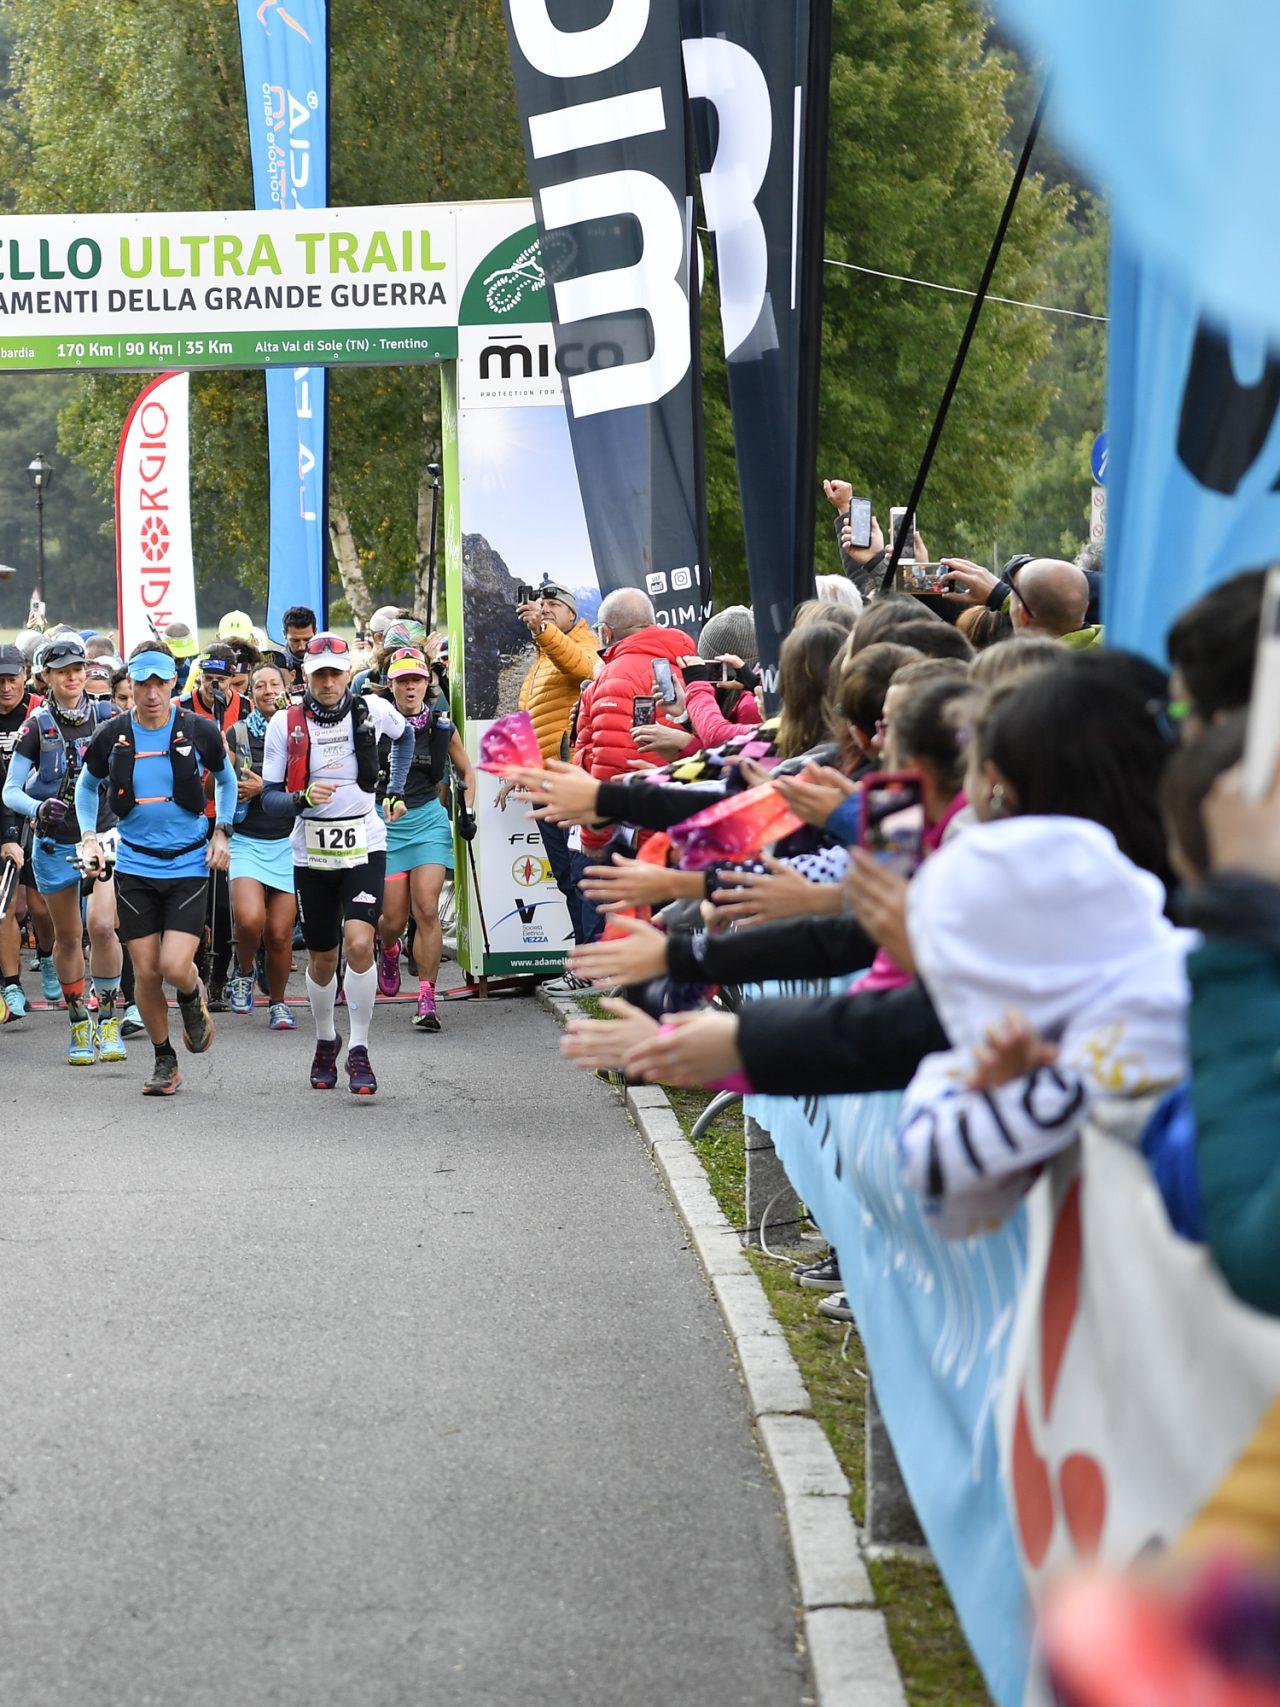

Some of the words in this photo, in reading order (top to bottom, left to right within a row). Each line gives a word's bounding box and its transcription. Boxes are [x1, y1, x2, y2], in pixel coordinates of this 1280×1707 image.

[119, 232, 282, 279] ULTRA
[295, 229, 446, 275] TRAIL
[108, 287, 195, 313] DELLA
[204, 283, 322, 311] GRANDE
[330, 281, 447, 308] GUERRA
[57, 343, 85, 358] 170
[89, 343, 113, 358] Km
[125, 341, 145, 357] 90
[149, 341, 174, 356] Km
[185, 340, 205, 355] 35
[208, 339, 234, 355] Km
[254, 341, 280, 353] Alta
[282, 341, 301, 353] Val
[303, 340, 314, 352] di
[317, 340, 343, 352] Sole
[345, 338, 370, 353] (TN)
[378, 338, 429, 351] Trentino
[315, 828, 356, 849] 126
